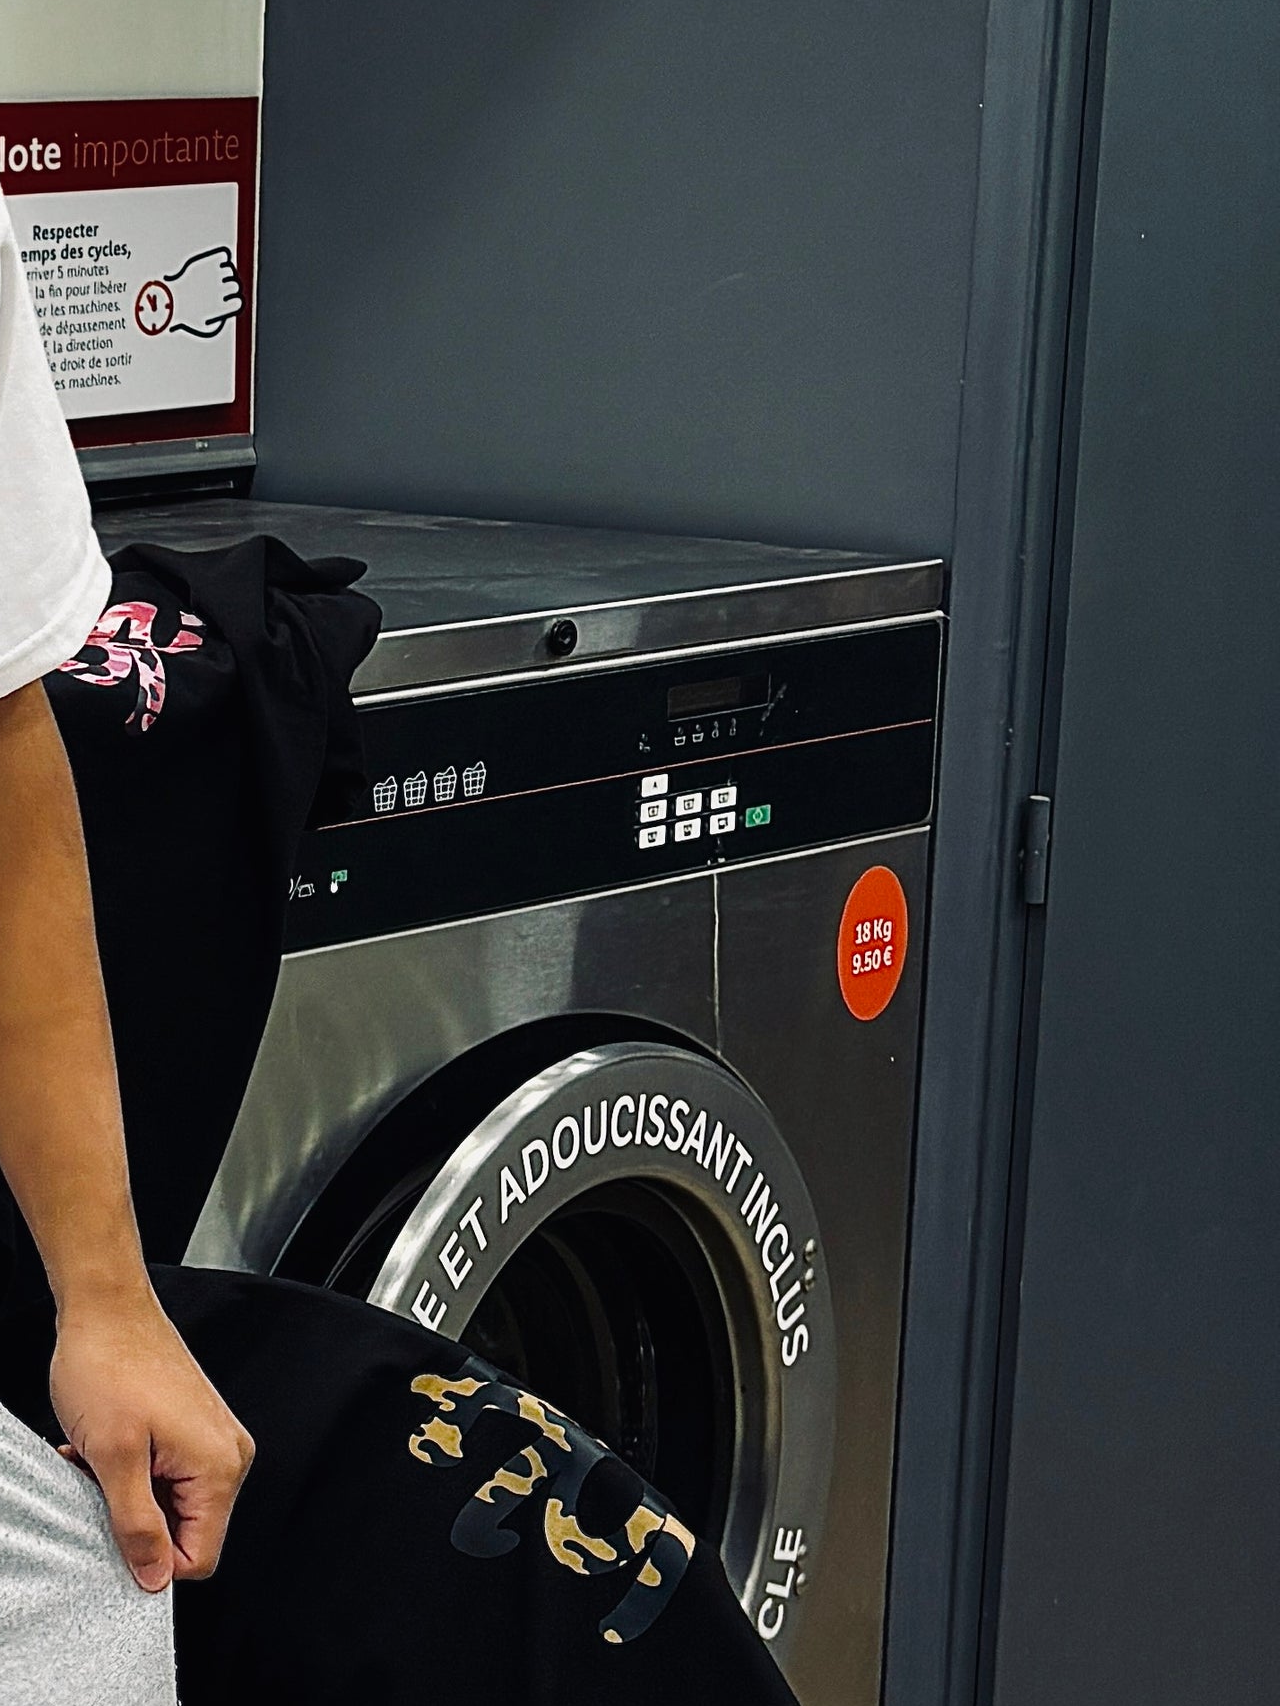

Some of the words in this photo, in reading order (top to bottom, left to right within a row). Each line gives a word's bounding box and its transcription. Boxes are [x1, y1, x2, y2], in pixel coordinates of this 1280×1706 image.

[72, 129, 240, 177] importante
[32, 224, 99, 244] Respecter
[61, 244, 84, 260] des
[88, 239, 132, 263] cycles,
[57, 265, 64, 279] 5
[67, 264, 110, 278] minutes
[48, 283, 63, 298] fin
[65, 284, 90, 300] pour
[93, 279, 127, 294] libérer
[50, 302, 66, 316] les
[56, 317, 126, 336] dépassement
[53, 340, 63, 354] la
[66, 336, 114, 353] direction
[60, 356, 86, 372] droit
[88, 356, 102, 370] de
[105, 352, 133, 368] sortir
[855, 921, 871, 945] 18
[873, 918, 893, 943] Kg
[852, 948, 882, 975] 9.50
[883, 945, 893, 966] €
[438, 1198, 489, 1291] ET
[498, 1093, 753, 1224] ADOUCISSANT
[739, 1172, 810, 1367] INCLUS
